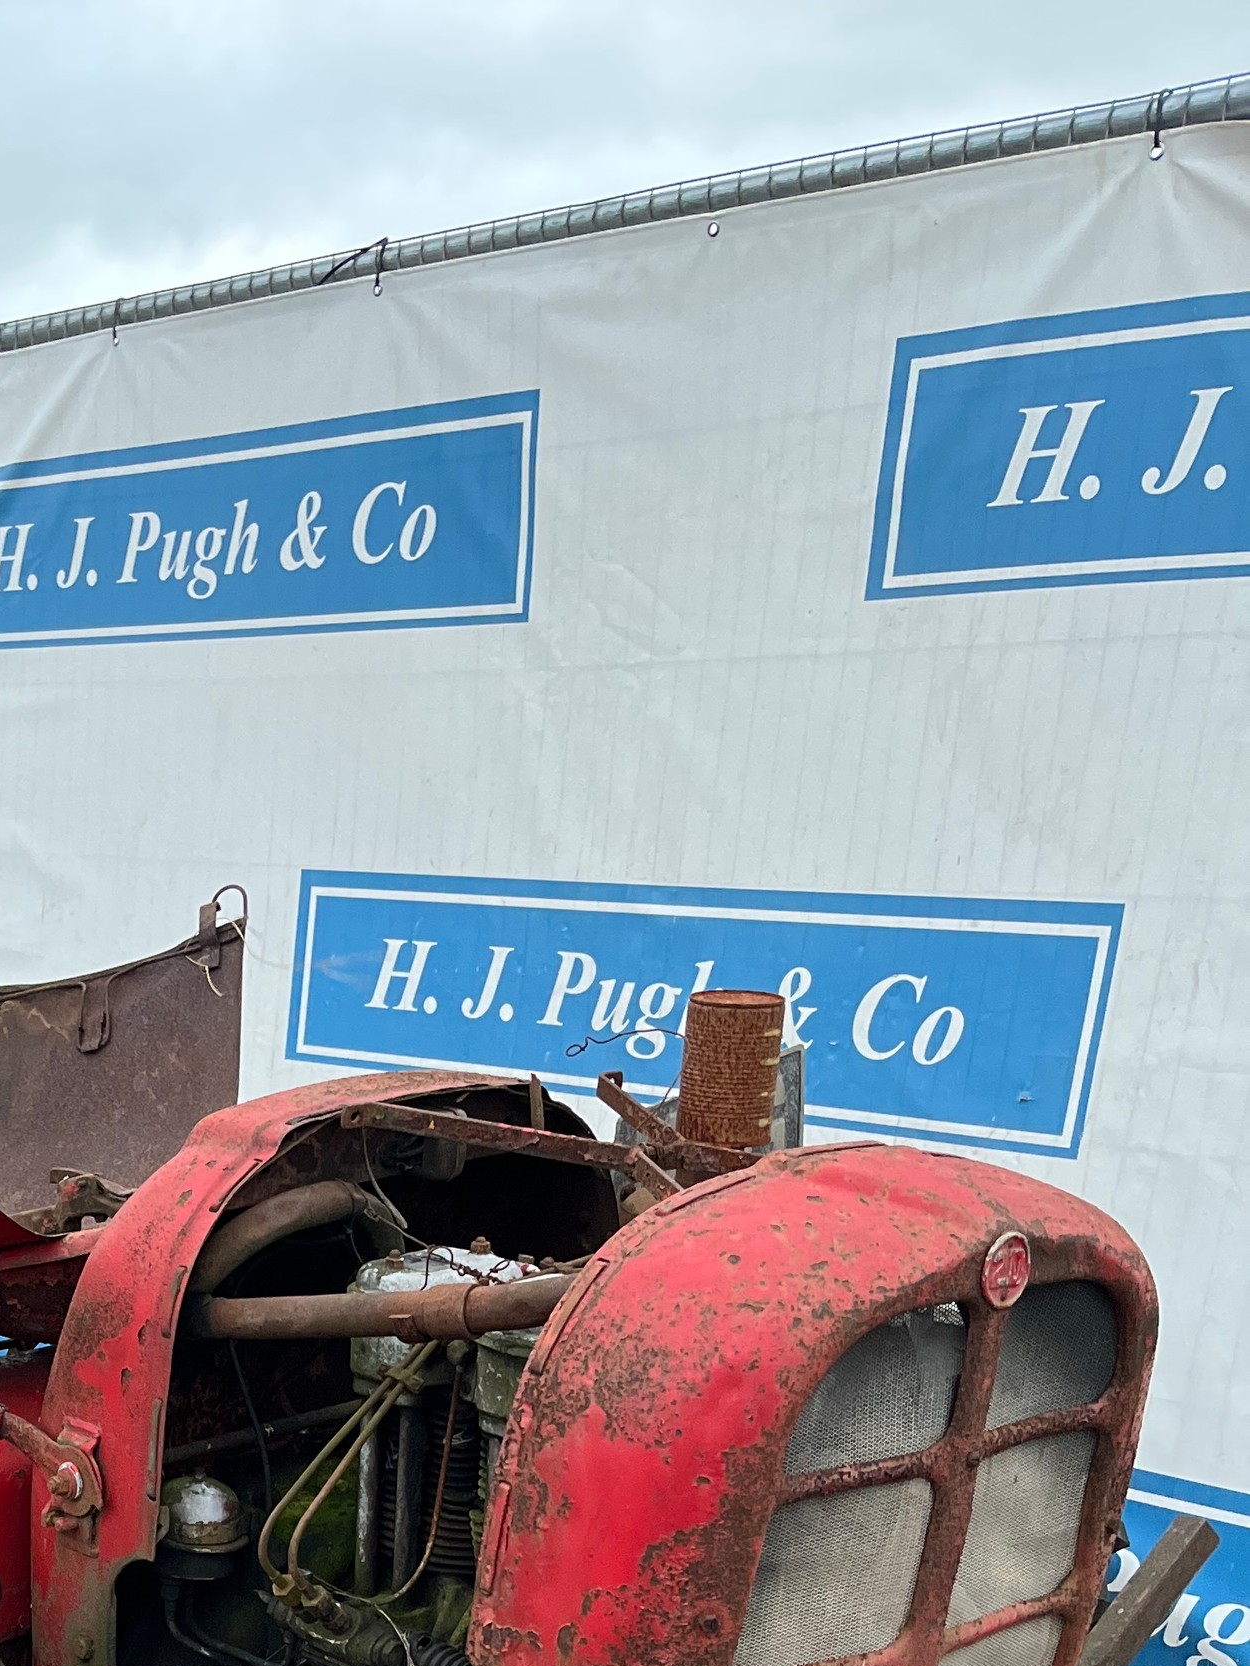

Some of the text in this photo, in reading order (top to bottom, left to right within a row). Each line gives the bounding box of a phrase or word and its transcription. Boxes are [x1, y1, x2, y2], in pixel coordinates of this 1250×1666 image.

[986, 386, 1234, 508] H. J.
[56, 517, 98, 588] J.
[116, 499, 259, 600] Pugh
[279, 490, 327, 572] &
[352, 480, 437, 565] Co
[364, 938, 438, 1015] H.
[461, 946, 515, 1022] J.
[852, 973, 965, 1066] Co
